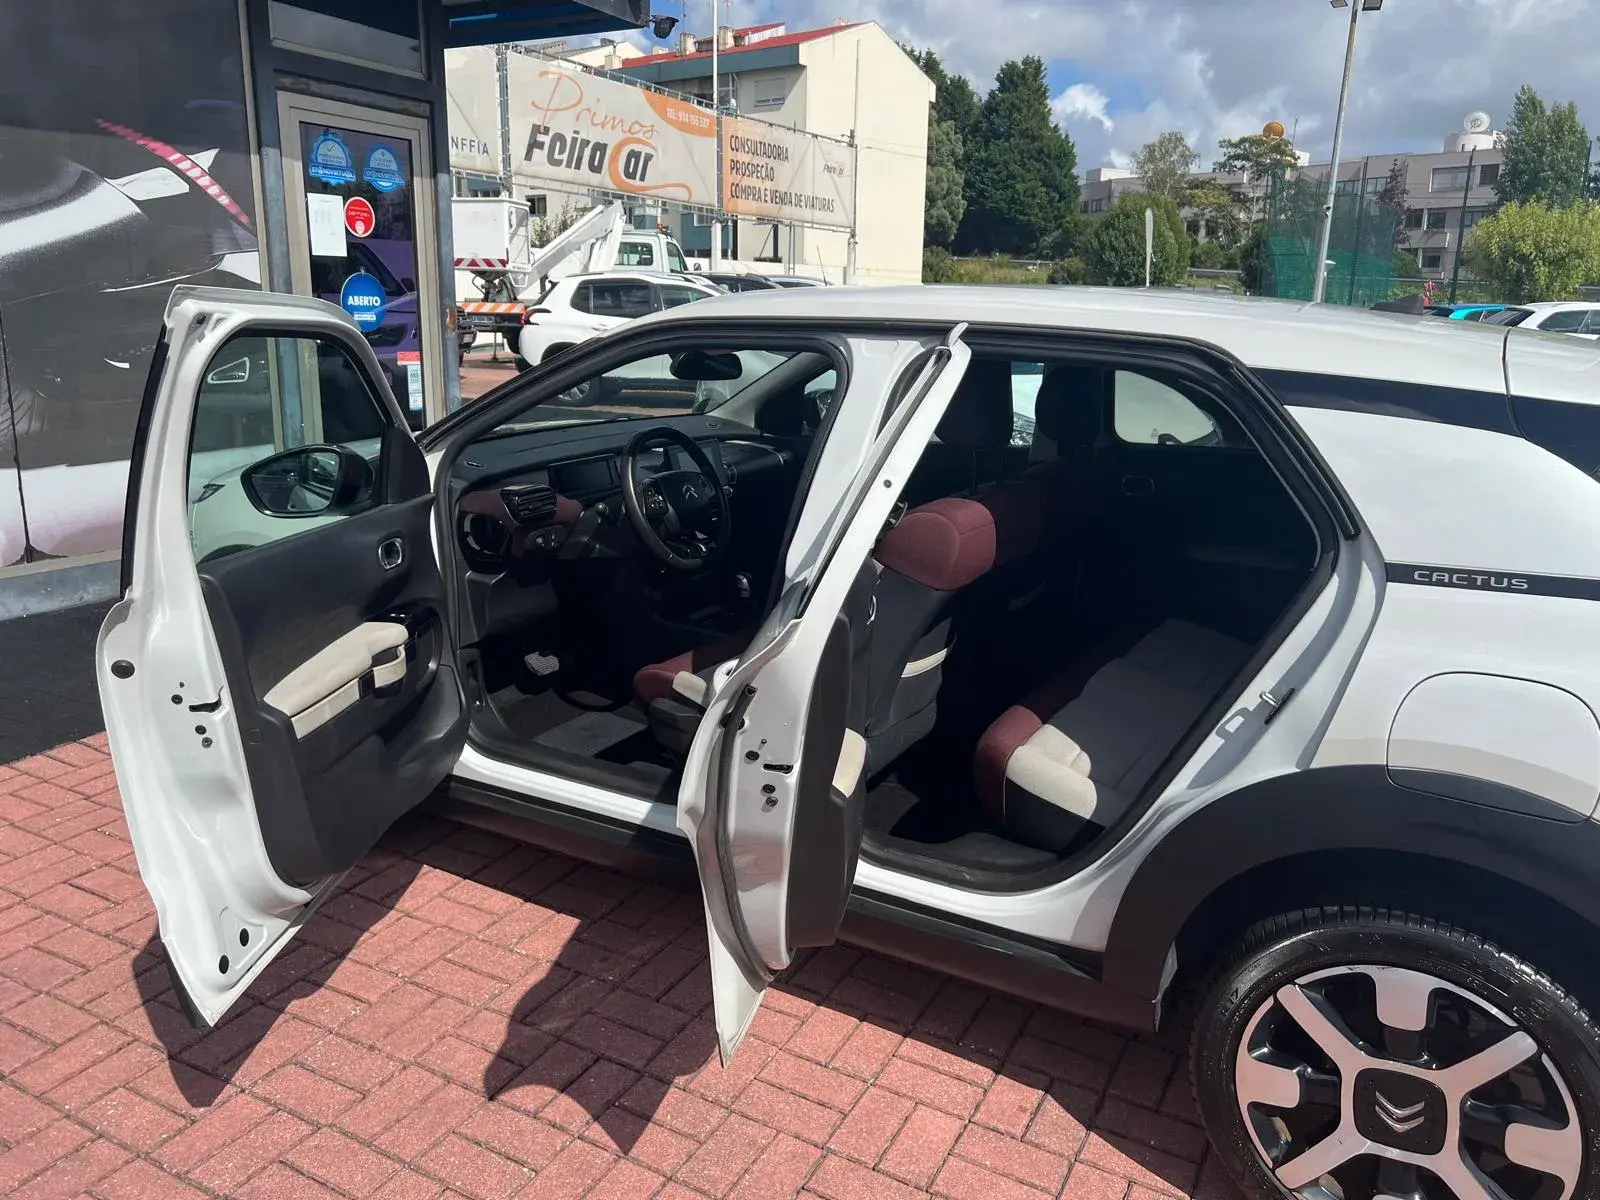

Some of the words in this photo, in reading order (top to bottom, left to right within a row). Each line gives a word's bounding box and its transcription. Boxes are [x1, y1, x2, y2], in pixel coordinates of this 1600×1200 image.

[532, 71, 660, 138] Primos
[729, 134, 789, 163] CONSULTADORIA
[730, 158, 775, 183] PROSPEÇÃO
[730, 182, 762, 203] COMPRA
[763, 188, 769, 202] E
[769, 189, 793, 207] VENDA
[794, 193, 803, 209] DE
[803, 194, 835, 213] VIATURAS
[347, 295, 381, 307] ABERTO
[1413, 570, 1529, 590] CACTUS
